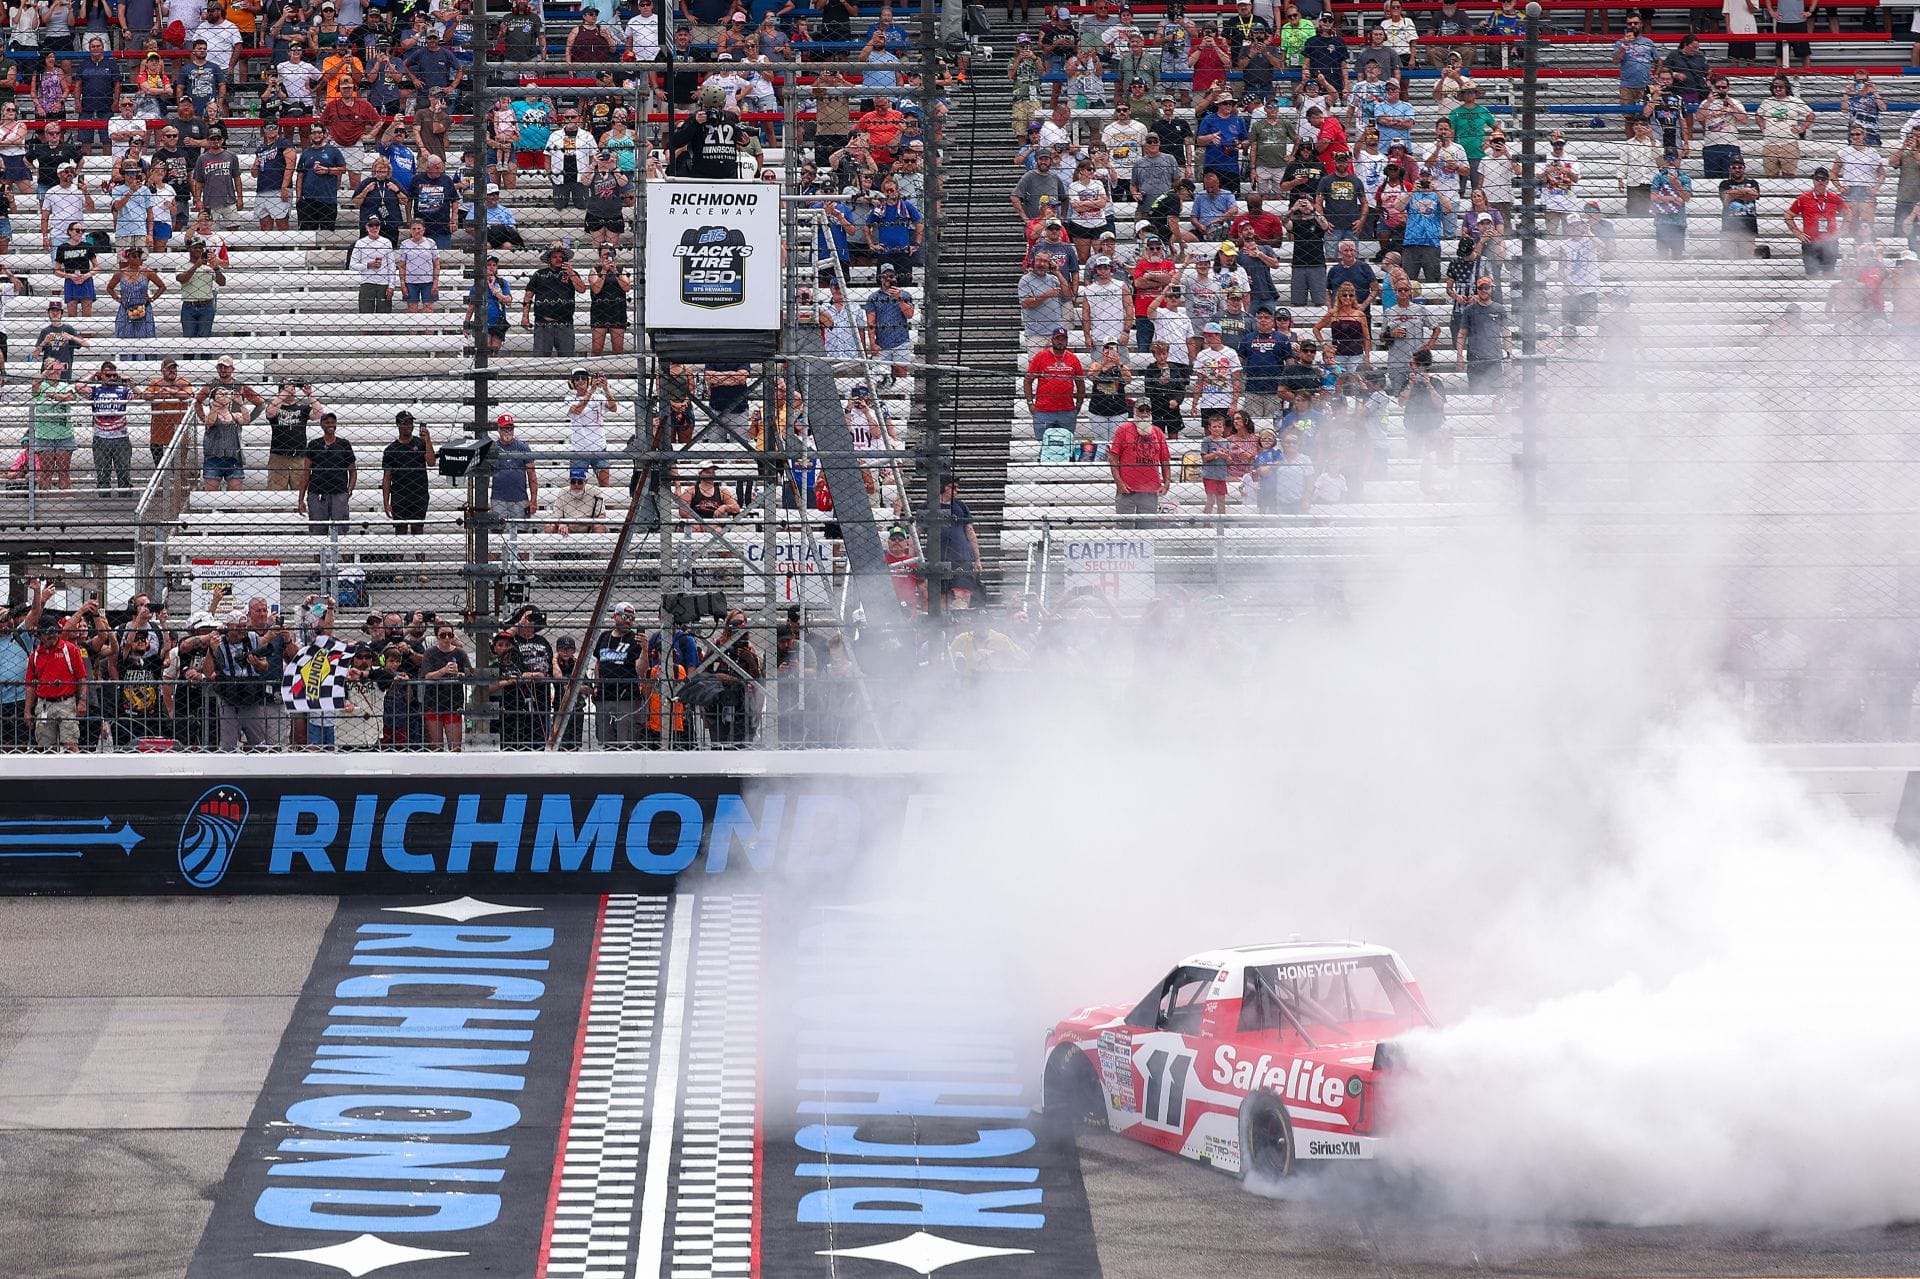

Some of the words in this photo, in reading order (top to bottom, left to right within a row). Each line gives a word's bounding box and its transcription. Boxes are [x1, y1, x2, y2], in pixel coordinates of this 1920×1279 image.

[704, 124, 735, 145] 212
[711, 145, 736, 154] NASCAR
[670, 193, 758, 206] RICHMOND
[669, 208, 756, 216] RACEWAY
[673, 245, 753, 257] BLACK'S
[689, 257, 733, 268] TIRE
[688, 270, 737, 284] 250
[1068, 542, 1150, 560] CAPITAL
[1085, 560, 1136, 571] SECTION
[1100, 572, 1119, 598] H
[269, 791, 862, 876] RICHMOND
[1276, 960, 1359, 981] HONEYCUTT
[253, 923, 555, 1233] RICHMOND
[1212, 1045, 1345, 1108] Safelite
[1146, 1049, 1192, 1128] 11
[1309, 1141, 1361, 1155] SiriusXM
